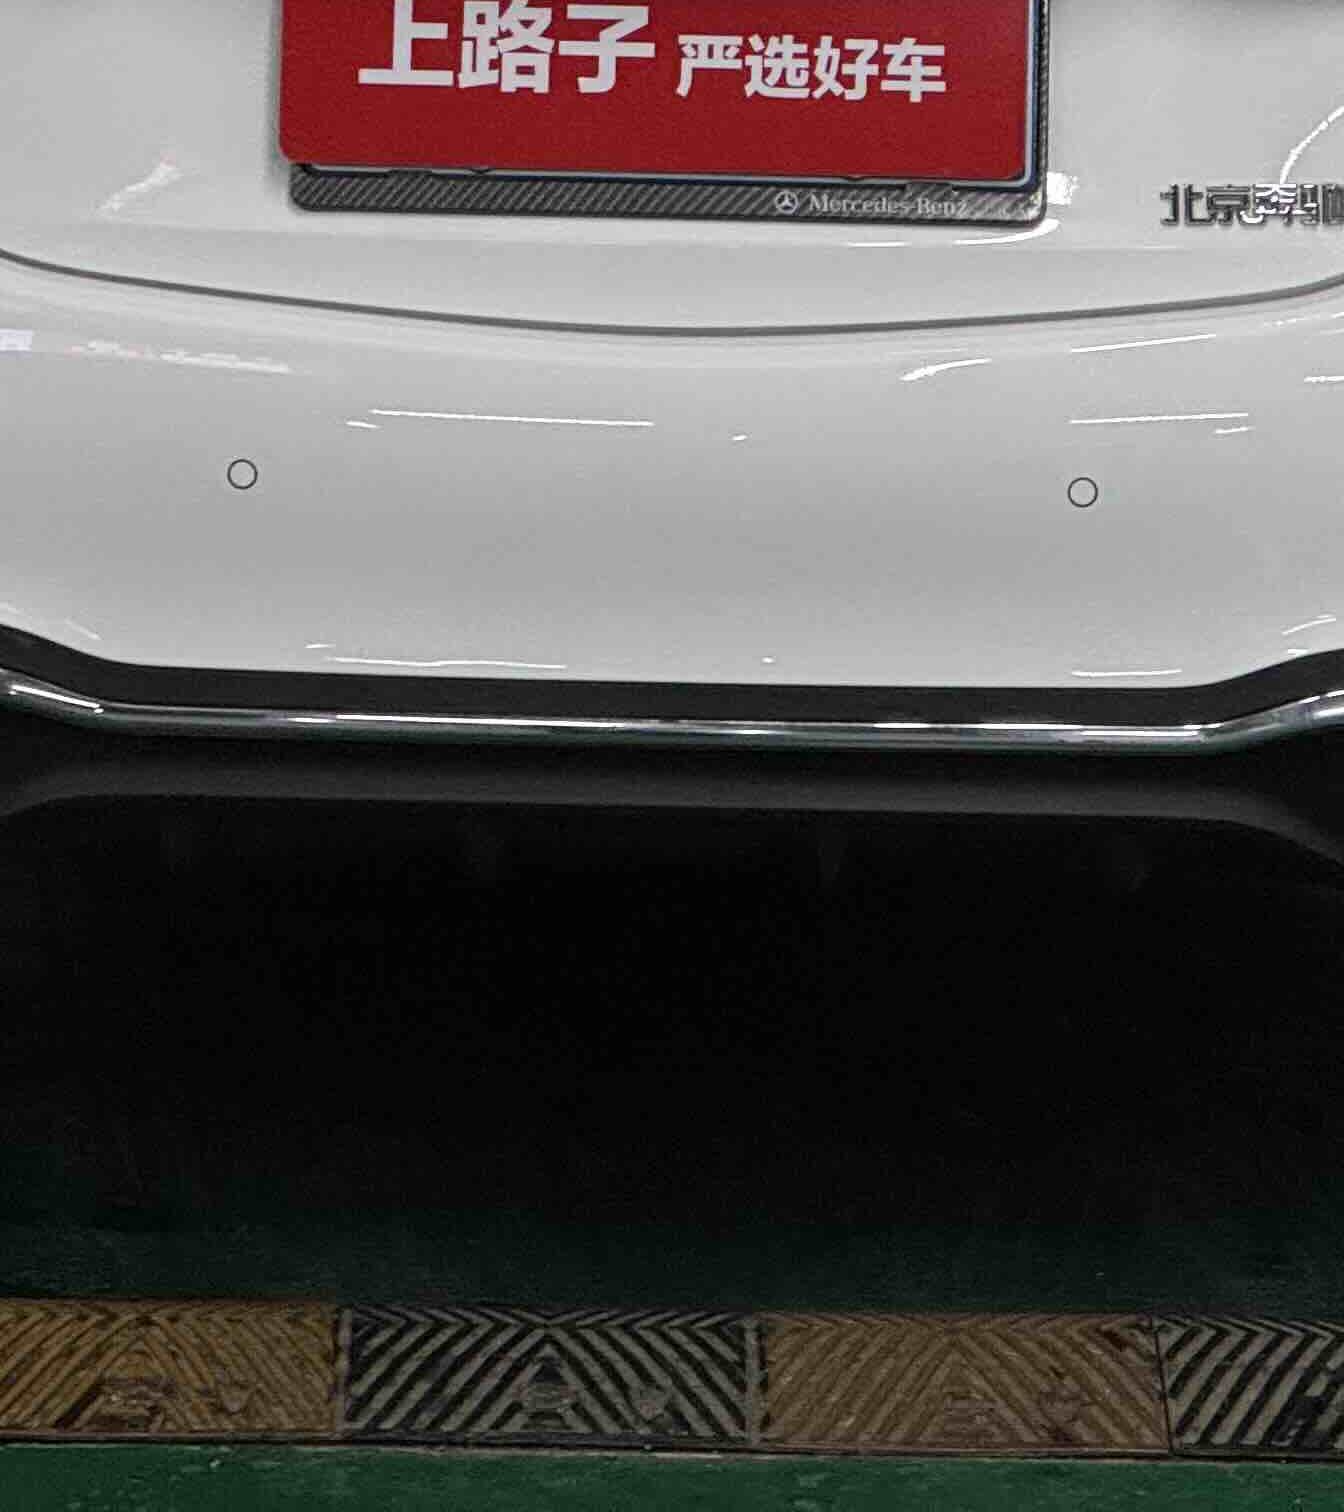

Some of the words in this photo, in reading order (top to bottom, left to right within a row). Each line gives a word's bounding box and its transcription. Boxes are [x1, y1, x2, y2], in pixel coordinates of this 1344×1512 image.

[675, 34, 947, 103] 严选好车
[808, 192, 971, 217] Mercedes-Benz
